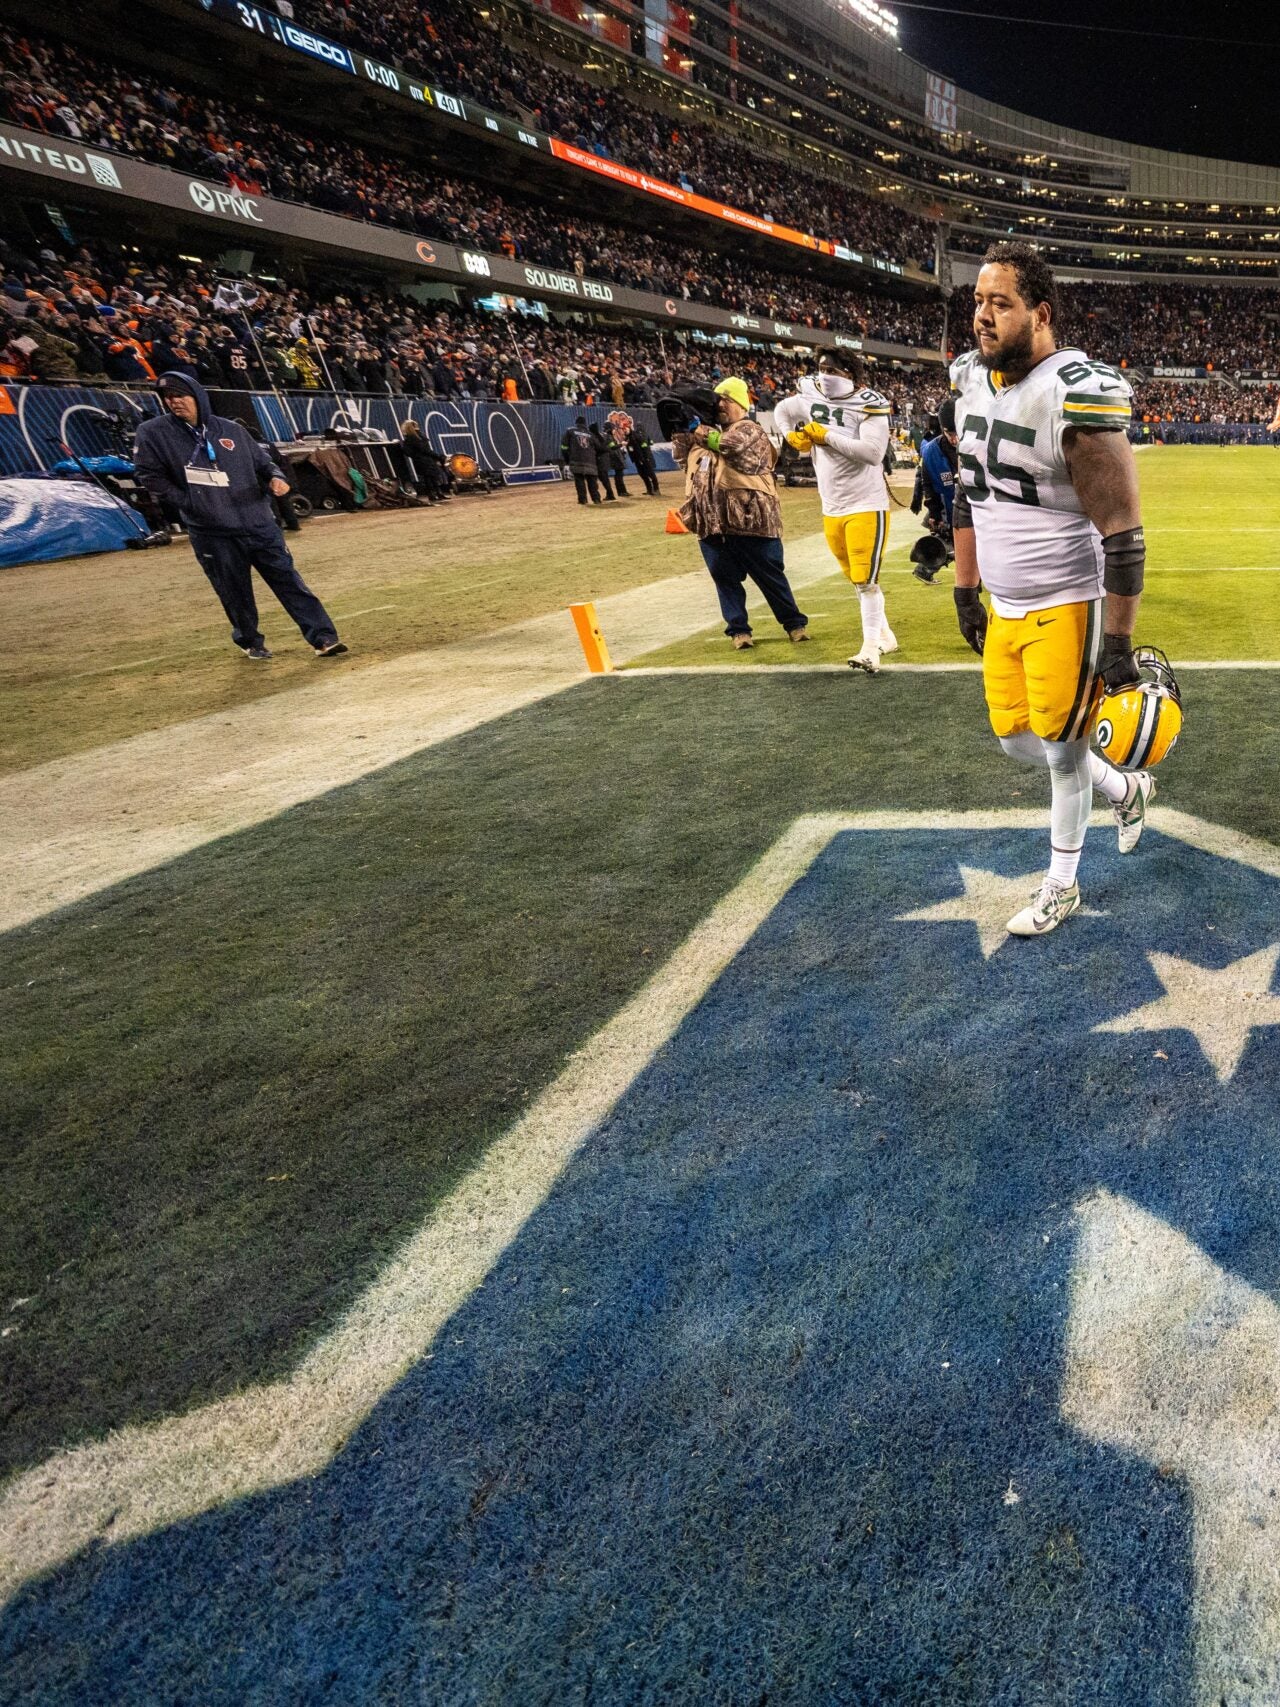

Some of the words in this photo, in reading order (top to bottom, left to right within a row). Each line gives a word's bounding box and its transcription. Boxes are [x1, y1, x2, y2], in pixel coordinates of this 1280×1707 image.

[239, 2, 266, 34] 31
[285, 25, 348, 66] GEICO
[363, 58, 400, 92] 0:00
[422, 85, 434, 106] 4
[438, 95, 458, 114] 40
[214, 189, 264, 223] PNC
[524, 267, 580, 296] SOLDIER
[582, 281, 614, 302] FIELD
[230, 354, 248, 370] 85
[1153, 367, 1196, 377] DOWN
[957, 413, 1042, 508] 65
